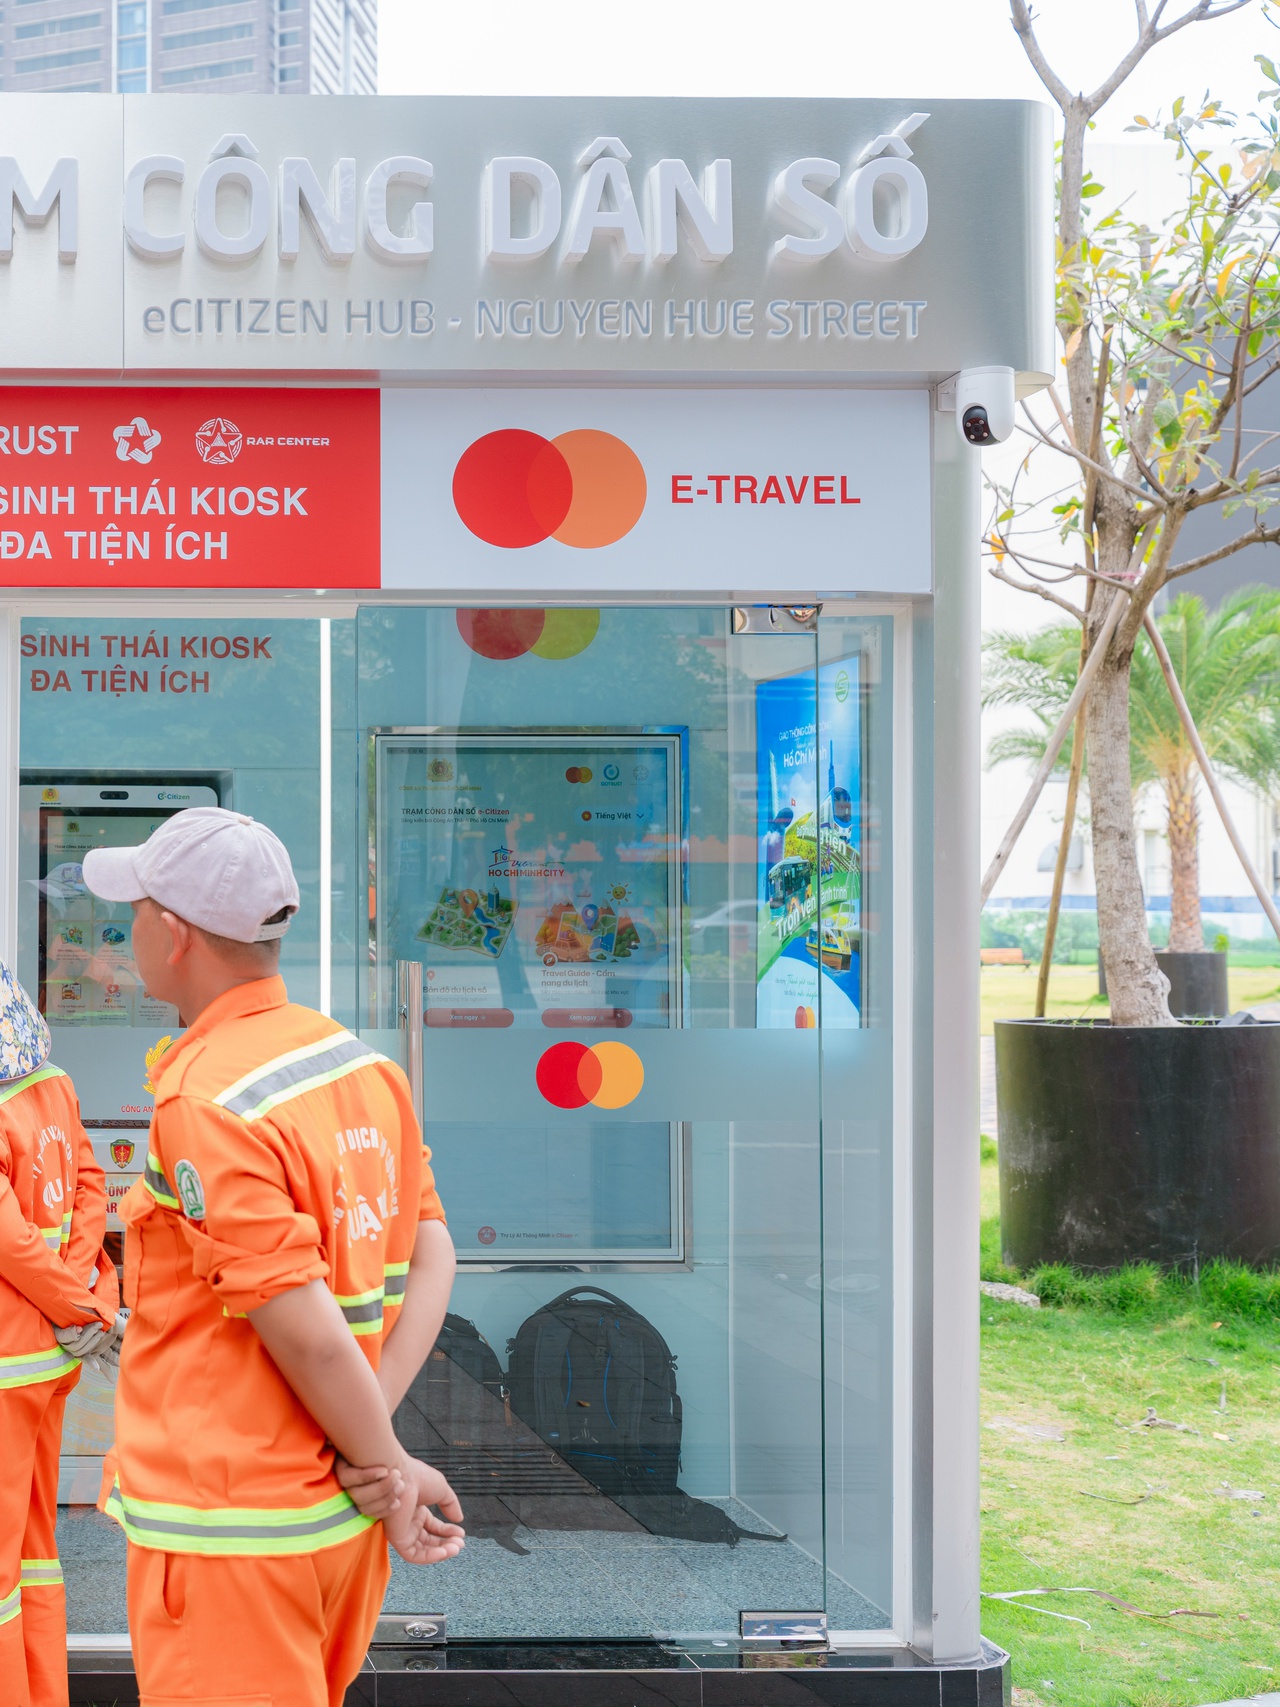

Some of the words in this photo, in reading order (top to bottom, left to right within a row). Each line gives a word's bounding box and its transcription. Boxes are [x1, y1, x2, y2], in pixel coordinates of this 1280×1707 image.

[125, 133, 434, 262] CÔNG
[486, 137, 733, 263] DÂN
[774, 113, 930, 262] SỐ
[143, 299, 328, 335] eCITIZEN
[346, 299, 434, 336] HUB
[477, 300, 652, 336] NGUYEN
[667, 300, 754, 336] HUE
[766, 300, 927, 338] STREET
[246, 436, 275, 446] RAR
[277, 436, 330, 446] CENTER
[88, 477, 173, 516] THÁI
[190, 486, 309, 517] KIOSK
[670, 474, 862, 505] E-TRAVEL
[0, 530, 53, 561] ĐA
[63, 523, 150, 566] TIỆN
[164, 524, 228, 560] ÍCH
[20, 634, 90, 658] SINH
[101, 629, 169, 658] THÁI
[180, 636, 273, 660] KIOSK
[30, 669, 72, 692] ĐA
[81, 664, 148, 698] TIỆN
[159, 665, 210, 693] ÍCH
[808, 745, 827, 762] Mnh
[401, 808, 423, 816] TRẠM
[466, 806, 477, 814] SỐ
[595, 811, 615, 821] Tiếng
[617, 811, 631, 821] Việt
[503, 869, 519, 877] CHI
[520, 869, 542, 877] MINH
[543, 869, 565, 877] CITY
[541, 969, 566, 977] Travel
[567, 969, 591, 977] Guide
[541, 980, 561, 988] nang
[121, 1104, 141, 1113] CÔNG
